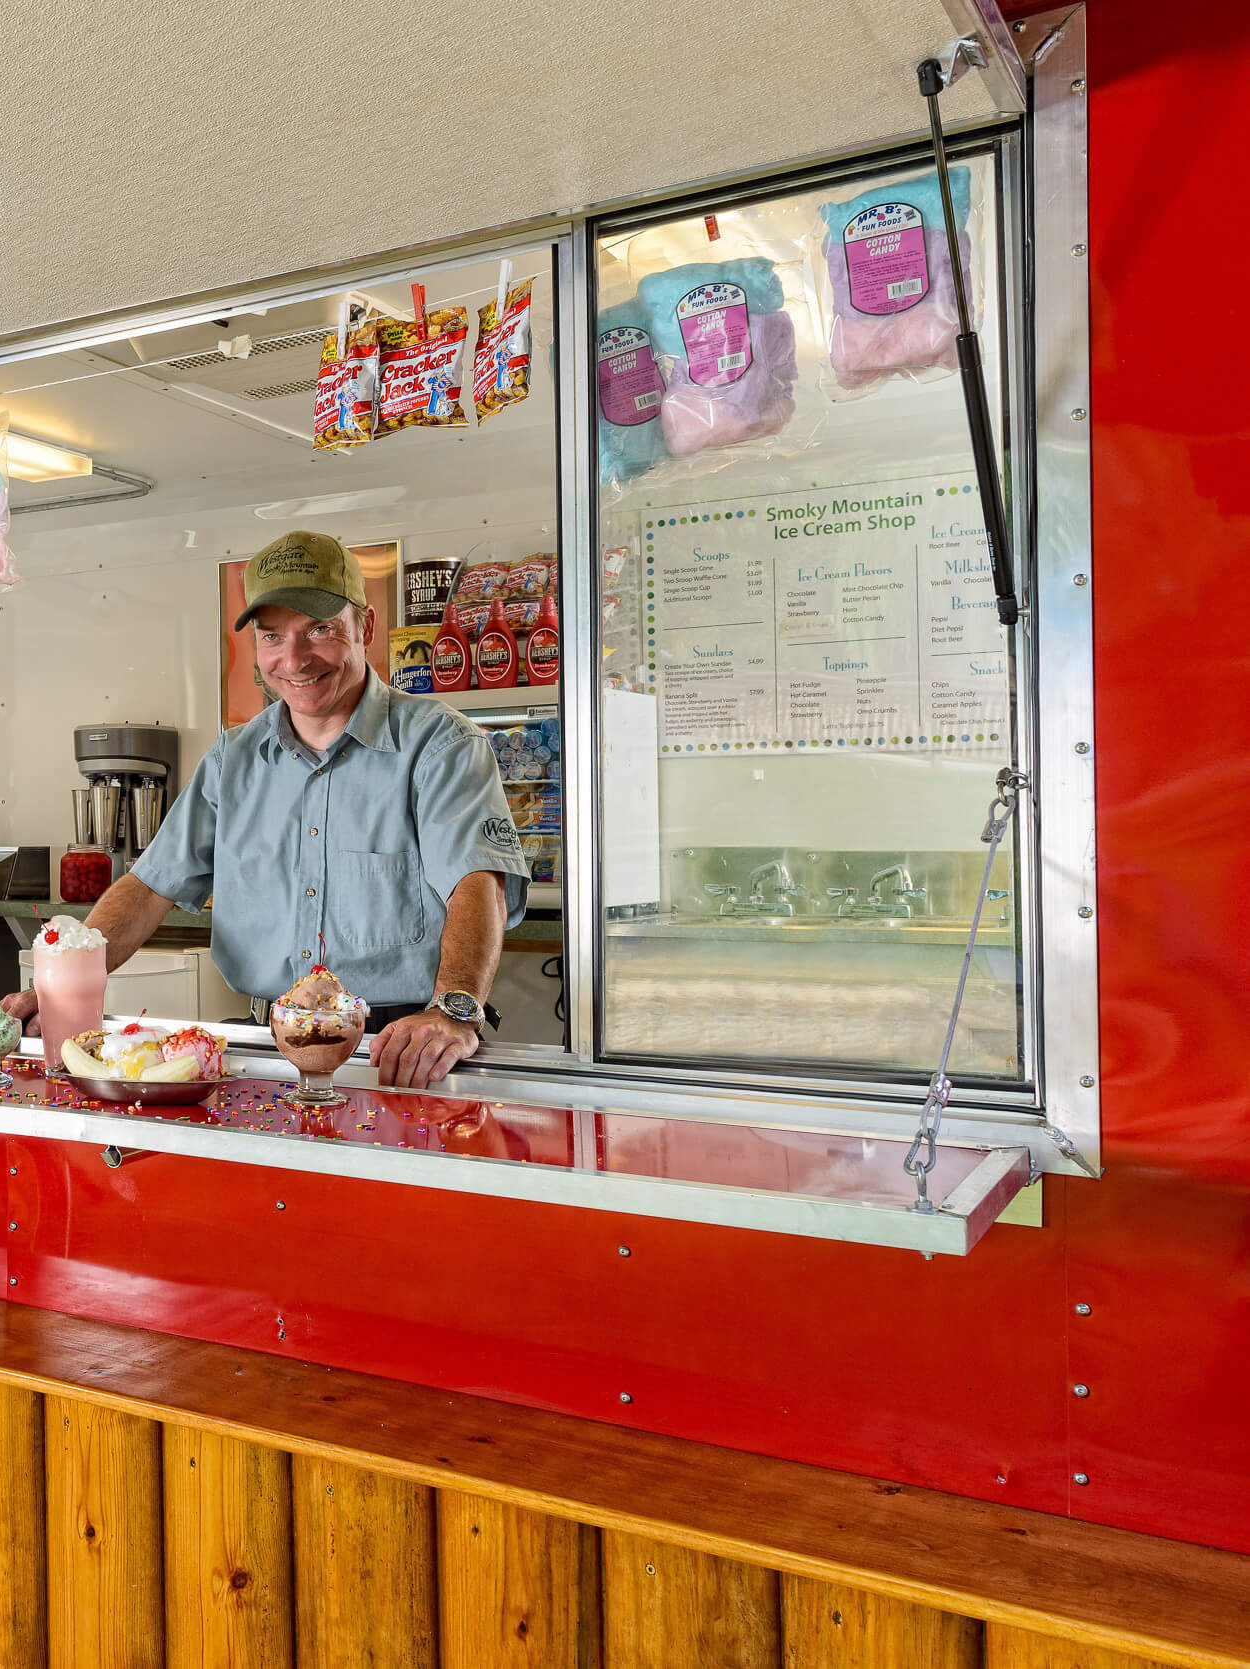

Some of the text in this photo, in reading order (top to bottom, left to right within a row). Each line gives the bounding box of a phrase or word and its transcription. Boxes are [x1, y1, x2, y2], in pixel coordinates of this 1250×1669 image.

[861, 217, 902, 231] FUN FOODS
[865, 233, 902, 248] COTTON
[869, 242, 901, 256] CANDY
[691, 295, 728, 309] FUN FOODS
[697, 310, 727, 325] COTTON
[701, 319, 726, 332] CANDY
[420, 335, 448, 352] Original
[601, 338, 634, 353] FUN FOODS
[381, 348, 457, 383] Cracker
[608, 351, 637, 368] COTTON
[612, 360, 637, 375] CANDY
[380, 375, 426, 403] Jack
[766, 491, 923, 522] Smoky Mountain
[774, 513, 916, 540] Ice Cream Shop
[931, 524, 946, 540] Ice
[693, 547, 731, 562] Scoops
[680, 566, 698, 574] Scoop
[798, 562, 893, 583] Ice Cream Flavors
[406, 569, 453, 590] ERSHEY'S
[931, 579, 951, 587] Vanilla
[786, 590, 817, 598] Chocolate
[857, 584, 888, 593] Chocolate
[889, 582, 904, 590] Chip
[411, 588, 437, 603] SYRUP
[787, 609, 819, 618] Strawberry
[842, 614, 885, 624] Cotton Candy
[480, 651, 508, 661] HERSHEY'S
[692, 643, 734, 659] Sundaes
[436, 654, 462, 665] HERSHEY'S
[822, 655, 869, 671] Toppings
[856, 687, 885, 695] Sprinkles
[931, 681, 950, 689] Chips
[790, 701, 820, 709] Chocolate
[873, 706, 898, 714] Crumbs
[959, 700, 982, 708] Apples
[790, 711, 823, 719] Strawberry
[483, 818, 517, 839] Westg
